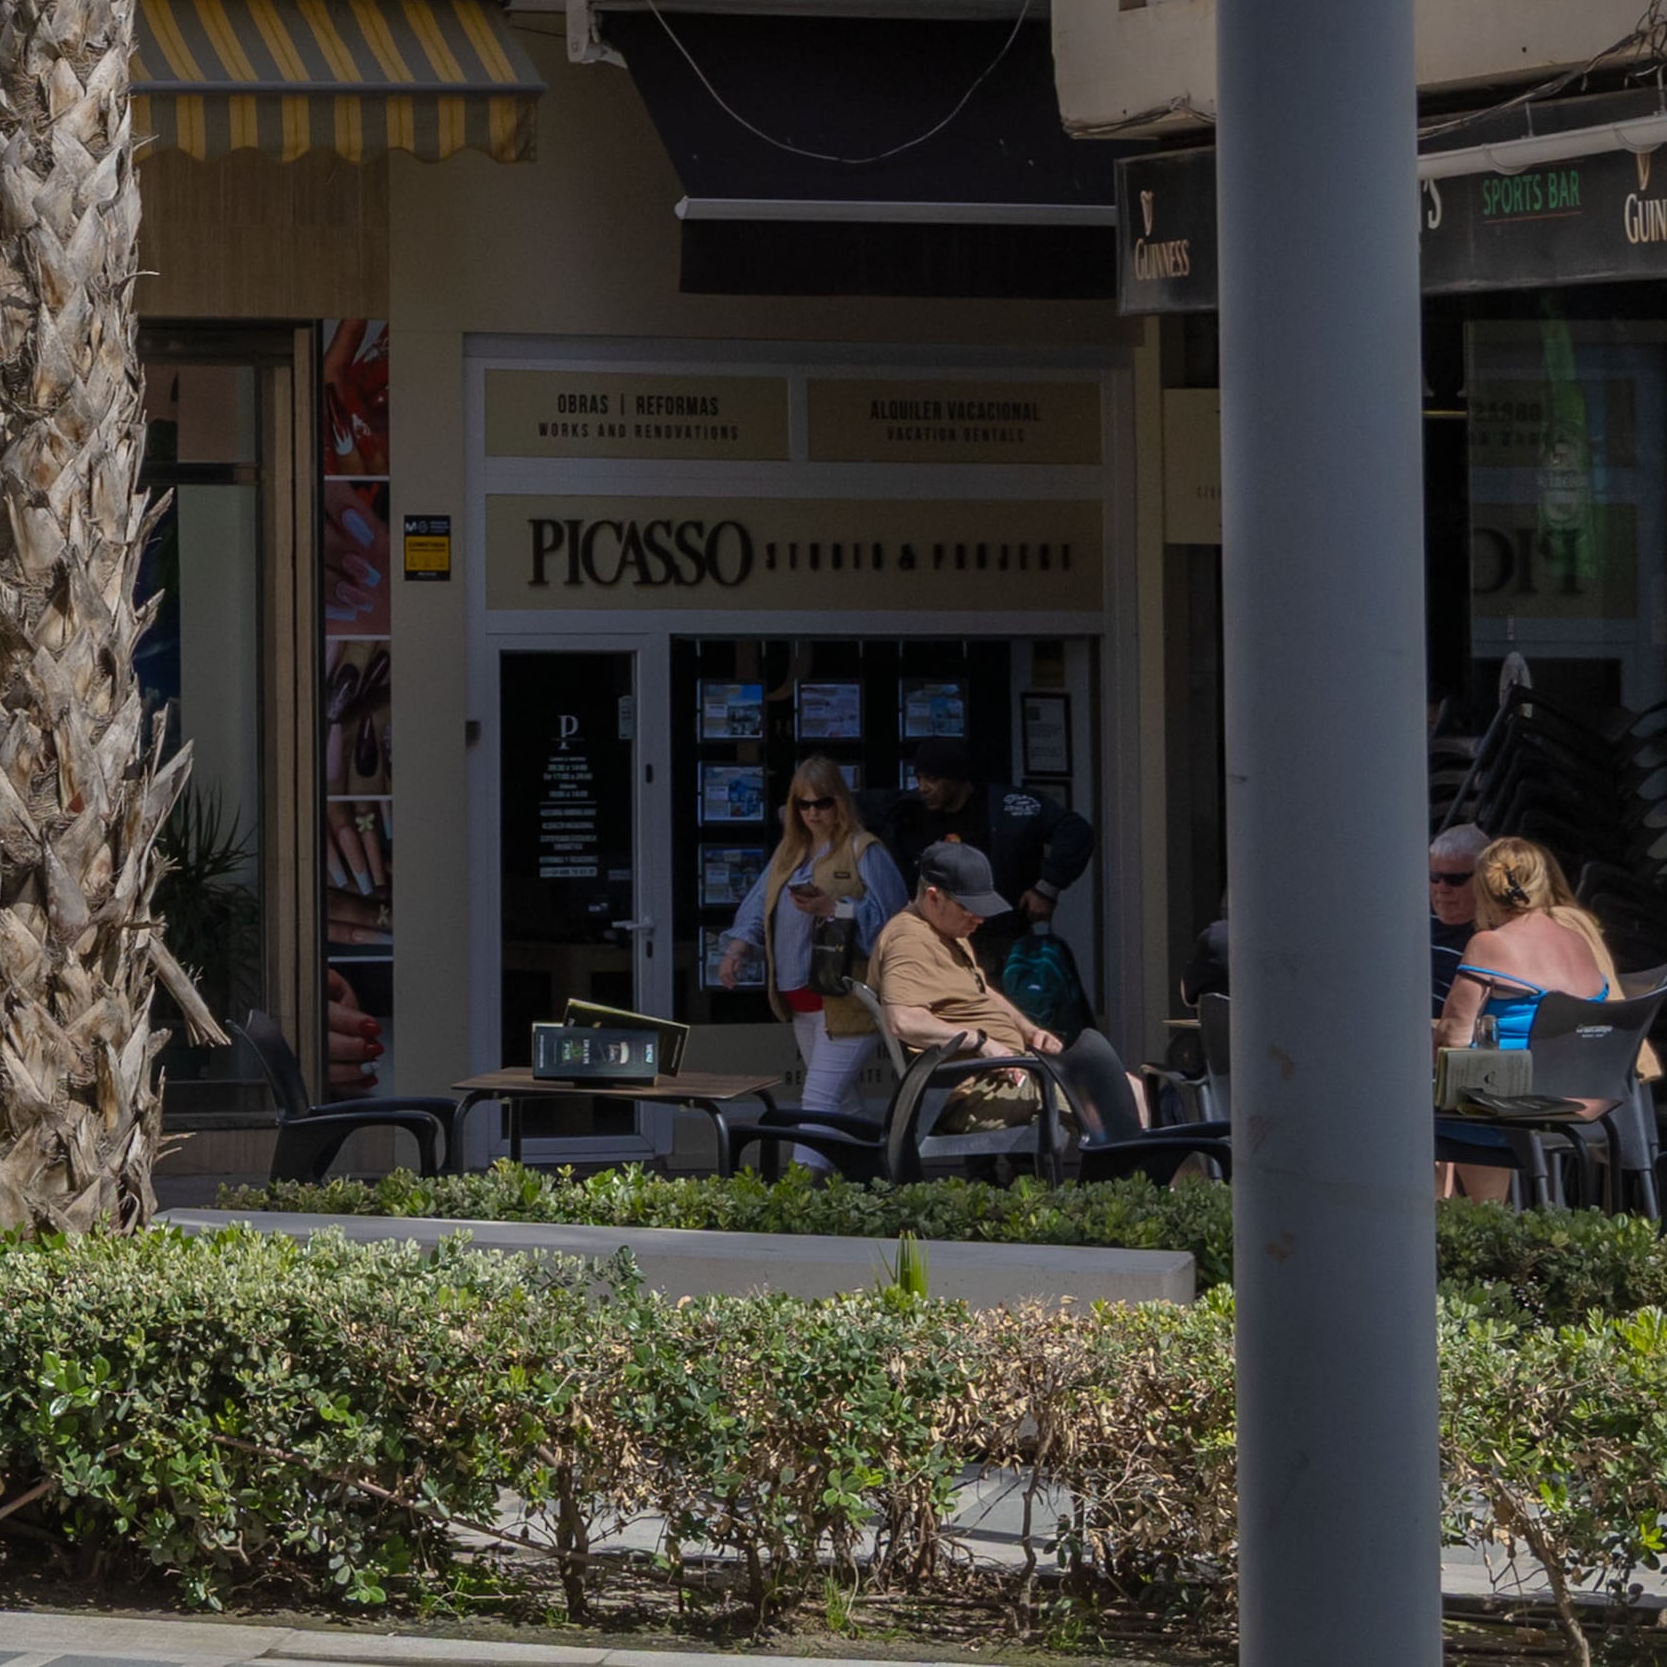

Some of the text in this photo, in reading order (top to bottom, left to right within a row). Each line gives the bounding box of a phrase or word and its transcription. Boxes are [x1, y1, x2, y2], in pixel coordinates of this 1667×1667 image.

[1482, 173, 1543, 216] SPORTS
[1547, 169, 1581, 210] BAR
[1134, 236, 1191, 282] GUINNESS
[557, 393, 719, 416] OBRAS REFORMAS
[870, 400, 1041, 422] ALQUILER VACACIONAL
[538, 422, 739, 441] WORKS AND RENOVATIONS
[527, 518, 754, 586] PICASSO
